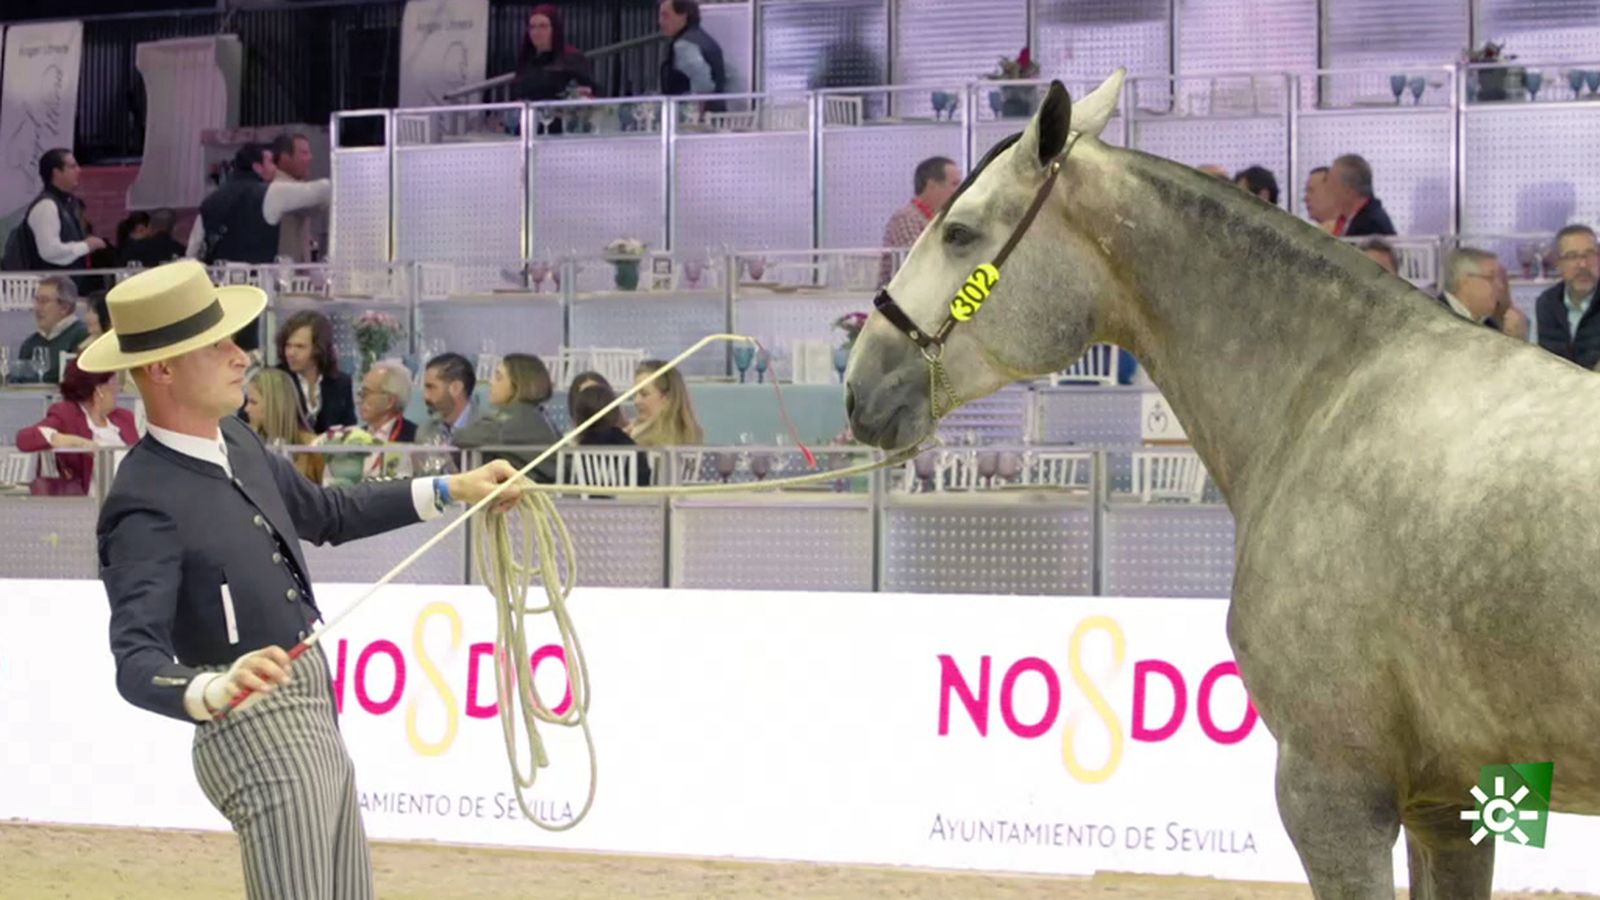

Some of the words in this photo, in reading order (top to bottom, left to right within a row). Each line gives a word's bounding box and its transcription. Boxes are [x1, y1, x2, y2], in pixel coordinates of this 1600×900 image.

[952, 268, 998, 316] 302
[359, 792, 450, 815] AMIENTO
[458, 795, 486, 817] DE
[929, 814, 1116, 849] AYUNTAMIENTO
[1125, 827, 1156, 850] DE
[1165, 822, 1258, 855] SEVILLA
